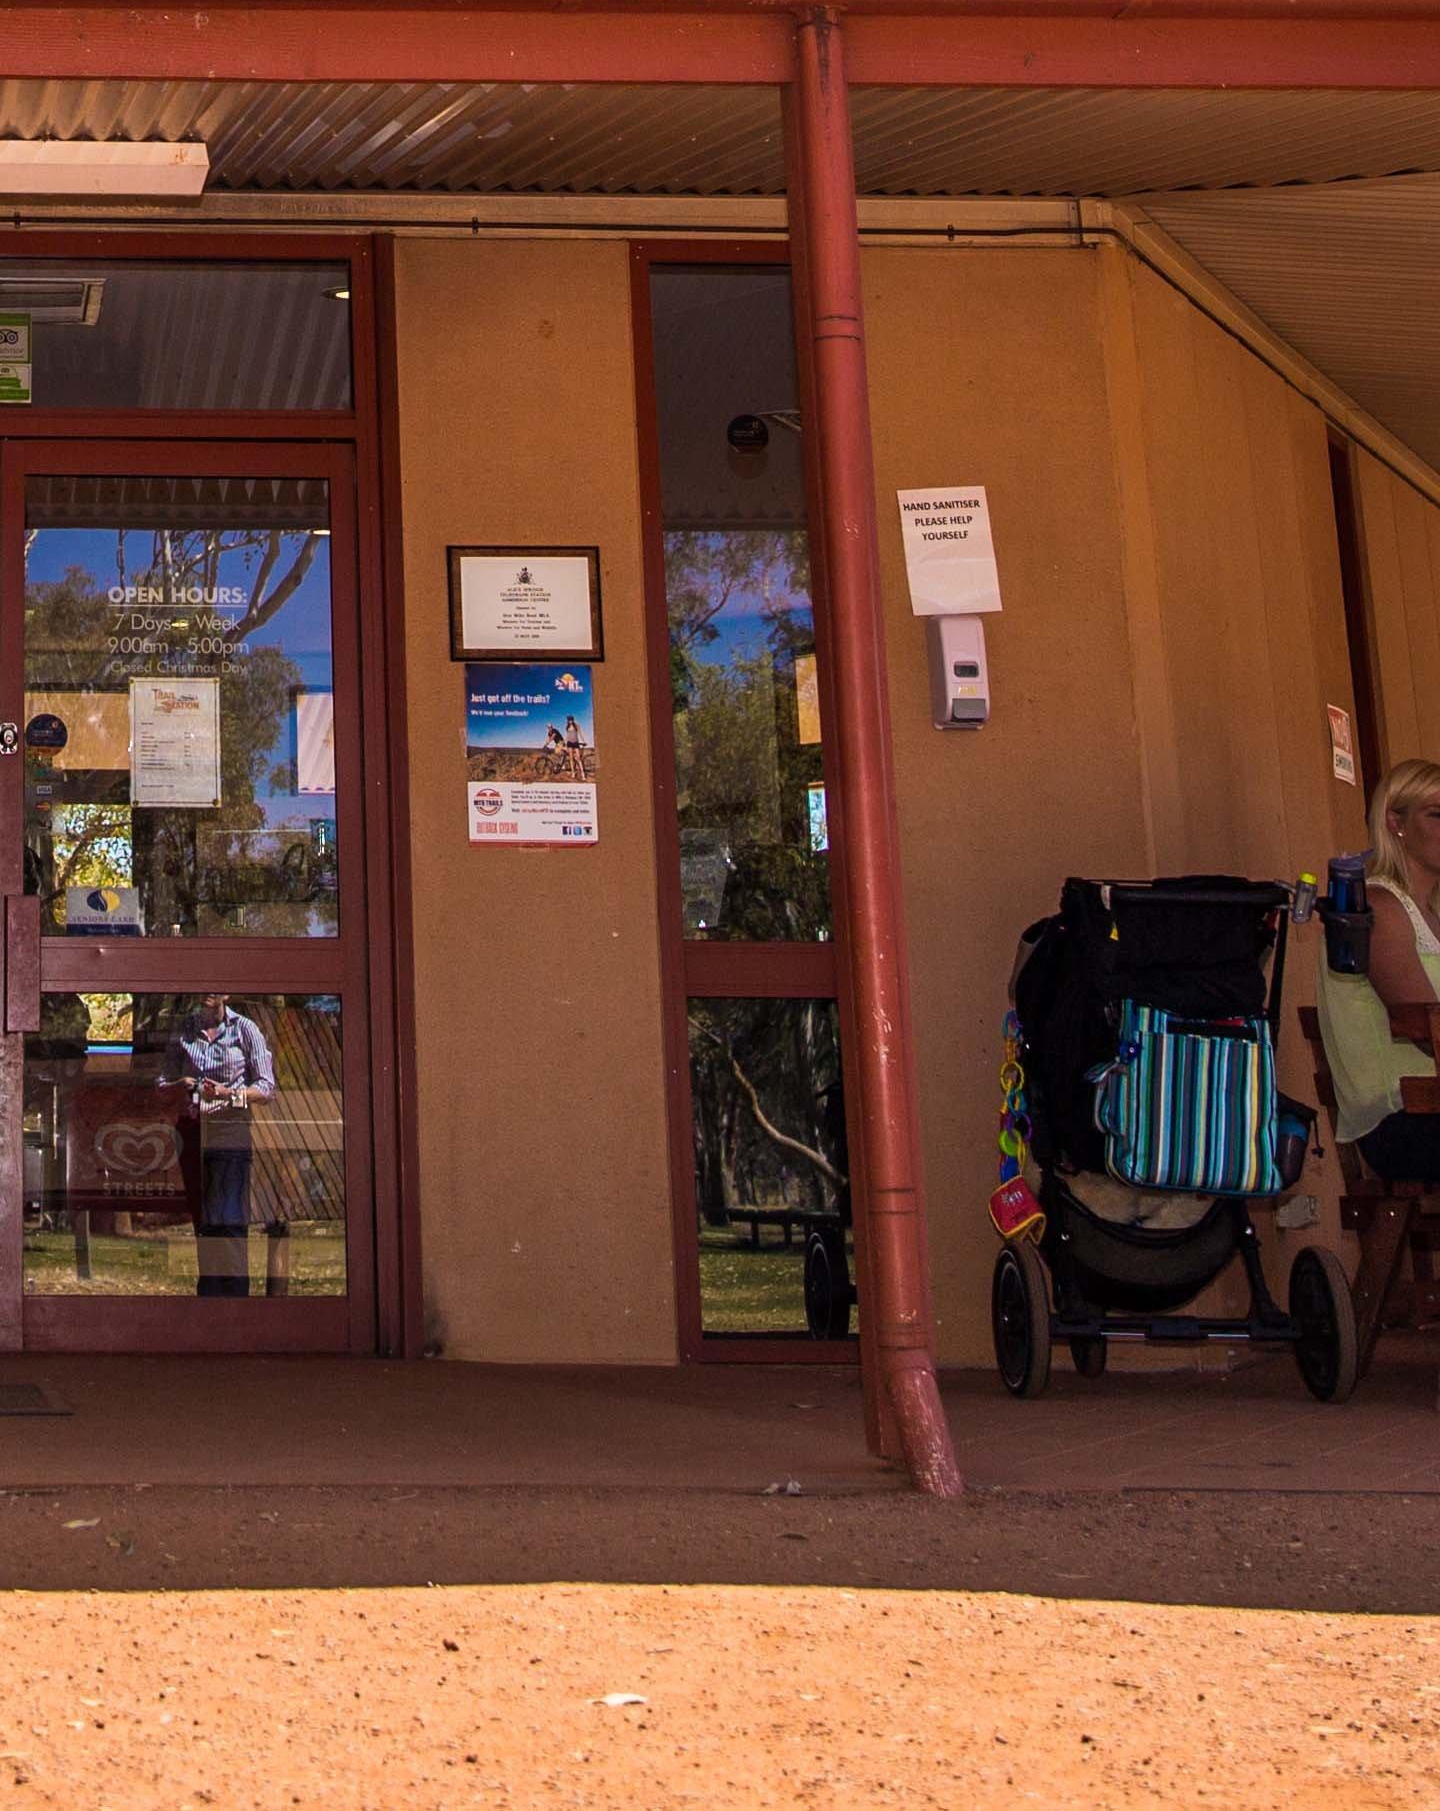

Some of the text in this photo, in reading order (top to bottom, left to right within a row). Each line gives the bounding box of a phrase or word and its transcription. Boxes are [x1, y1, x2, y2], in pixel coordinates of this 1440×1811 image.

[903, 499, 981, 511] HAND SANITISER
[914, 515, 973, 527] PLEASE HELP
[921, 530, 969, 541] YOURSELF
[107, 586, 248, 604] OPEN HOURS:
[114, 614, 125, 630] 7
[131, 613, 172, 635] Days
[195, 613, 241, 631] Week
[110, 660, 248, 676] Closed Christmas Day
[470, 693, 551, 705] Just got off the trails?
[102, 1181, 176, 1198] STREETS
